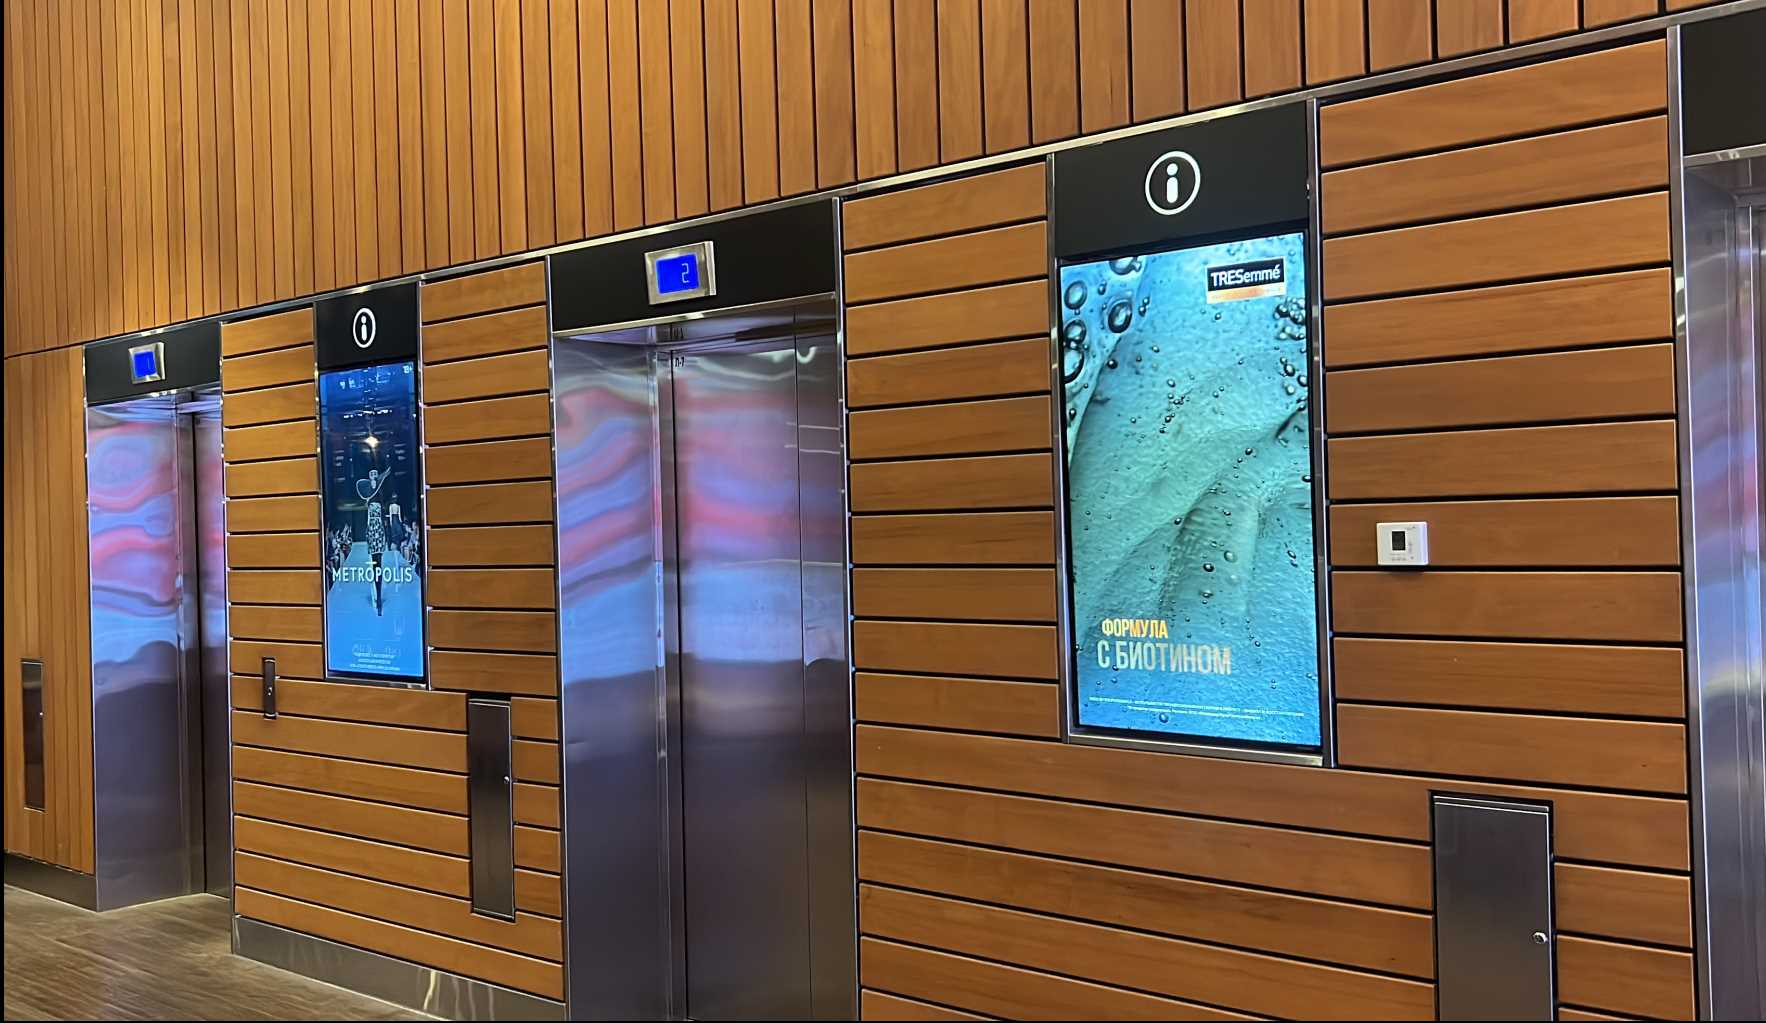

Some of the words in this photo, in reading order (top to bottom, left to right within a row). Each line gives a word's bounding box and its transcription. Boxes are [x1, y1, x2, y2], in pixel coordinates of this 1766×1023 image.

[1210, 263, 1281, 287] TRESemmé
[332, 566, 413, 583] METROPOLIS
[1101, 618, 1169, 639] ФОРМУЛА
[1115, 640, 1233, 675] БИОТИНОМ
